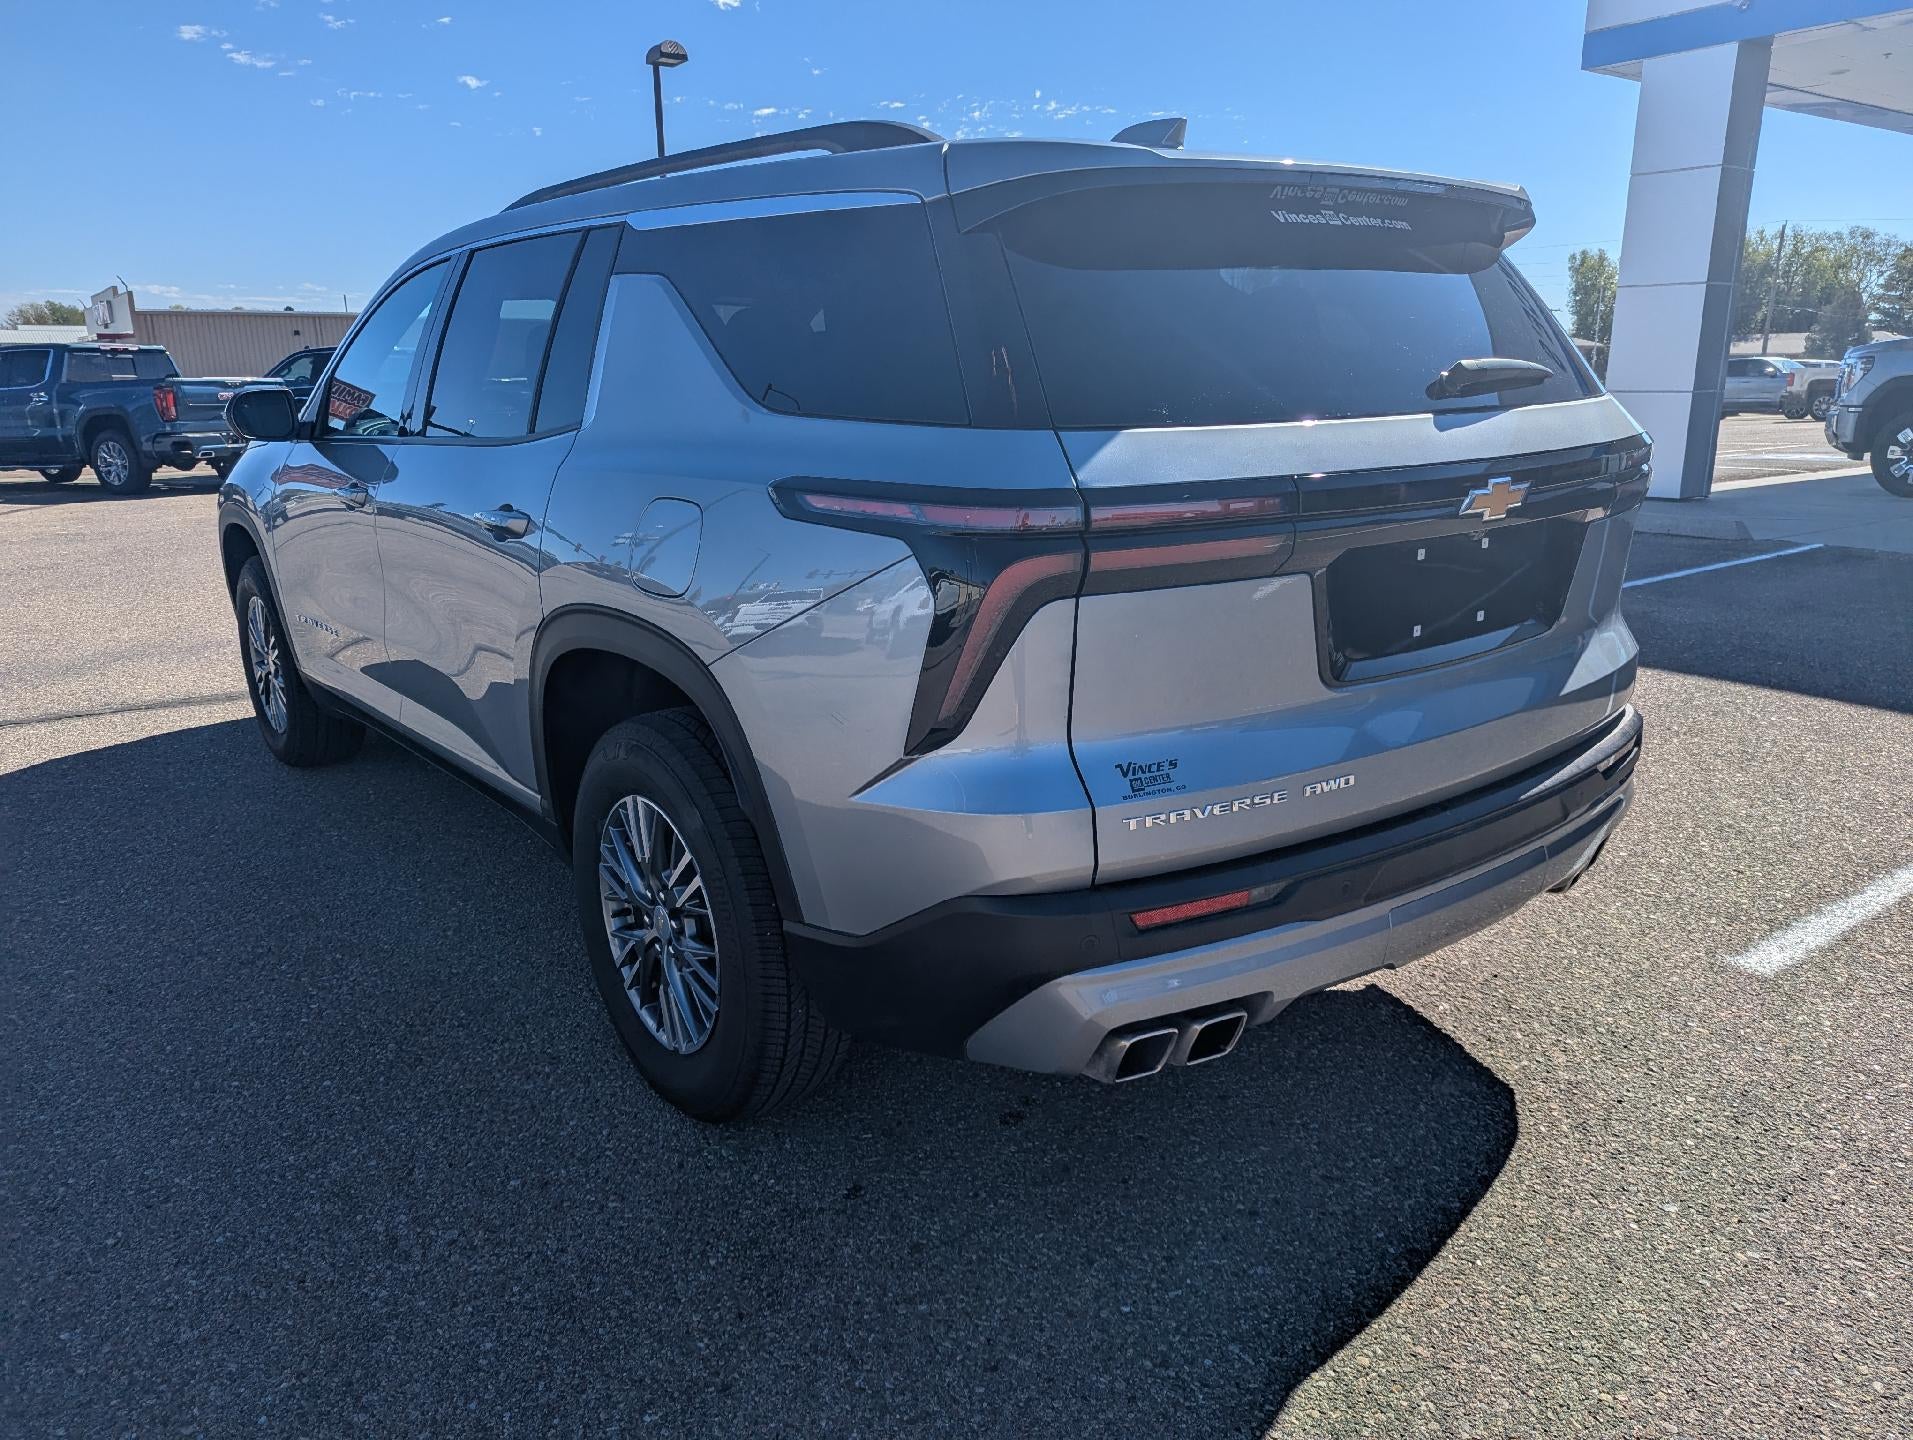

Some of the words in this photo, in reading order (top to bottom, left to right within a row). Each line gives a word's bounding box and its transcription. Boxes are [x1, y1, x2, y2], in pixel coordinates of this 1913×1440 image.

[1144, 773, 1172, 785] CENTER
[1303, 774, 1355, 797] AWD
[1122, 790, 1288, 831] TRAVERSE
